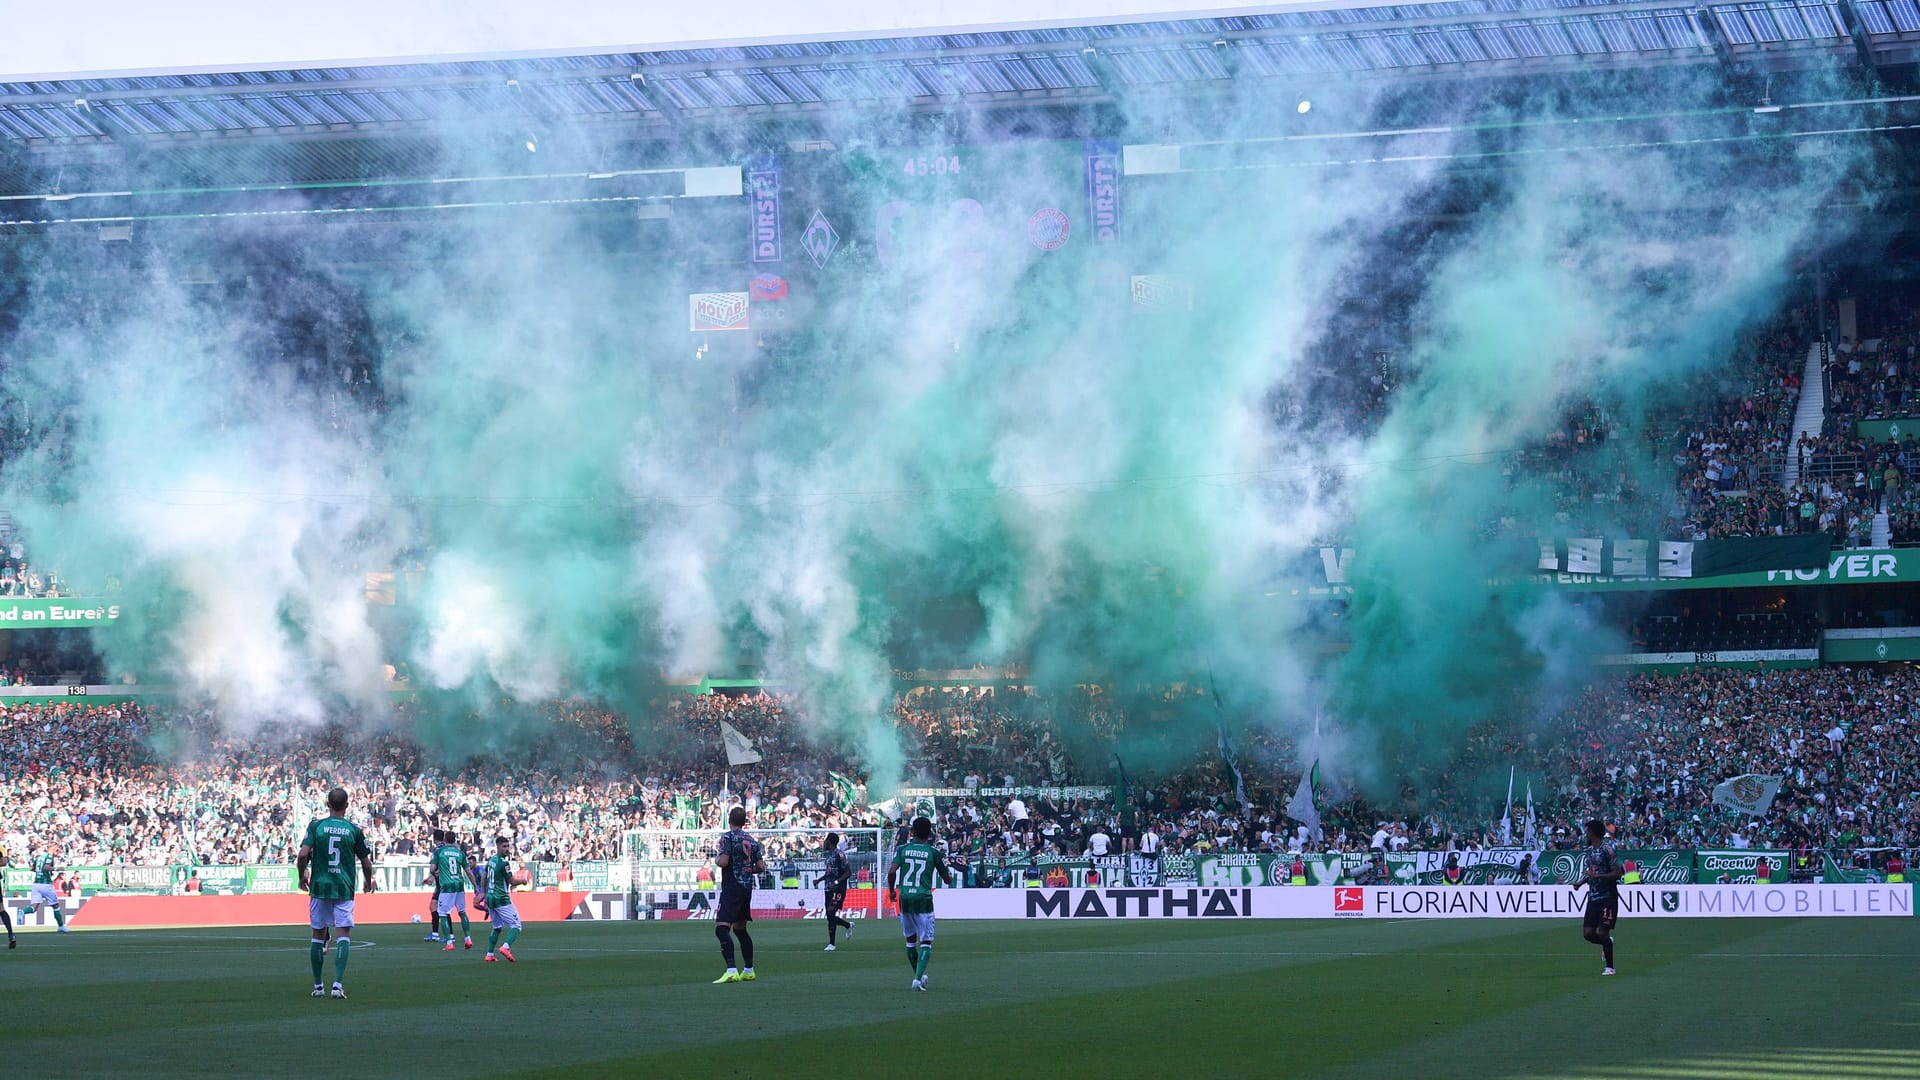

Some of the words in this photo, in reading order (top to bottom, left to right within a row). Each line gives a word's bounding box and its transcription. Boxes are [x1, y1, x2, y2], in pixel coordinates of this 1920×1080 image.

[903, 155, 960, 176] 45:04
[757, 176, 776, 256] DURST?
[21, 609, 46, 620] an
[68, 686, 86, 695] 138
[981, 787, 1021, 797] ULTRAS
[323, 826, 350, 836] WERDER
[328, 836, 342, 866] 5
[905, 849, 929, 858] WERDER
[1220, 853, 1257, 865] alianza
[448, 856, 458, 875] 8
[1704, 856, 1782, 871] GreenWte
[107, 866, 170, 883] PAPENBURG
[902, 858, 927, 887] 27
[1026, 889, 1251, 917] MATTHÄI
[1377, 890, 1488, 913] FLORIAN
[1496, 890, 1655, 913] WELLMNN
[1685, 889, 1908, 912] IMMOBILIEN
[803, 907, 867, 919] Zilrtal
